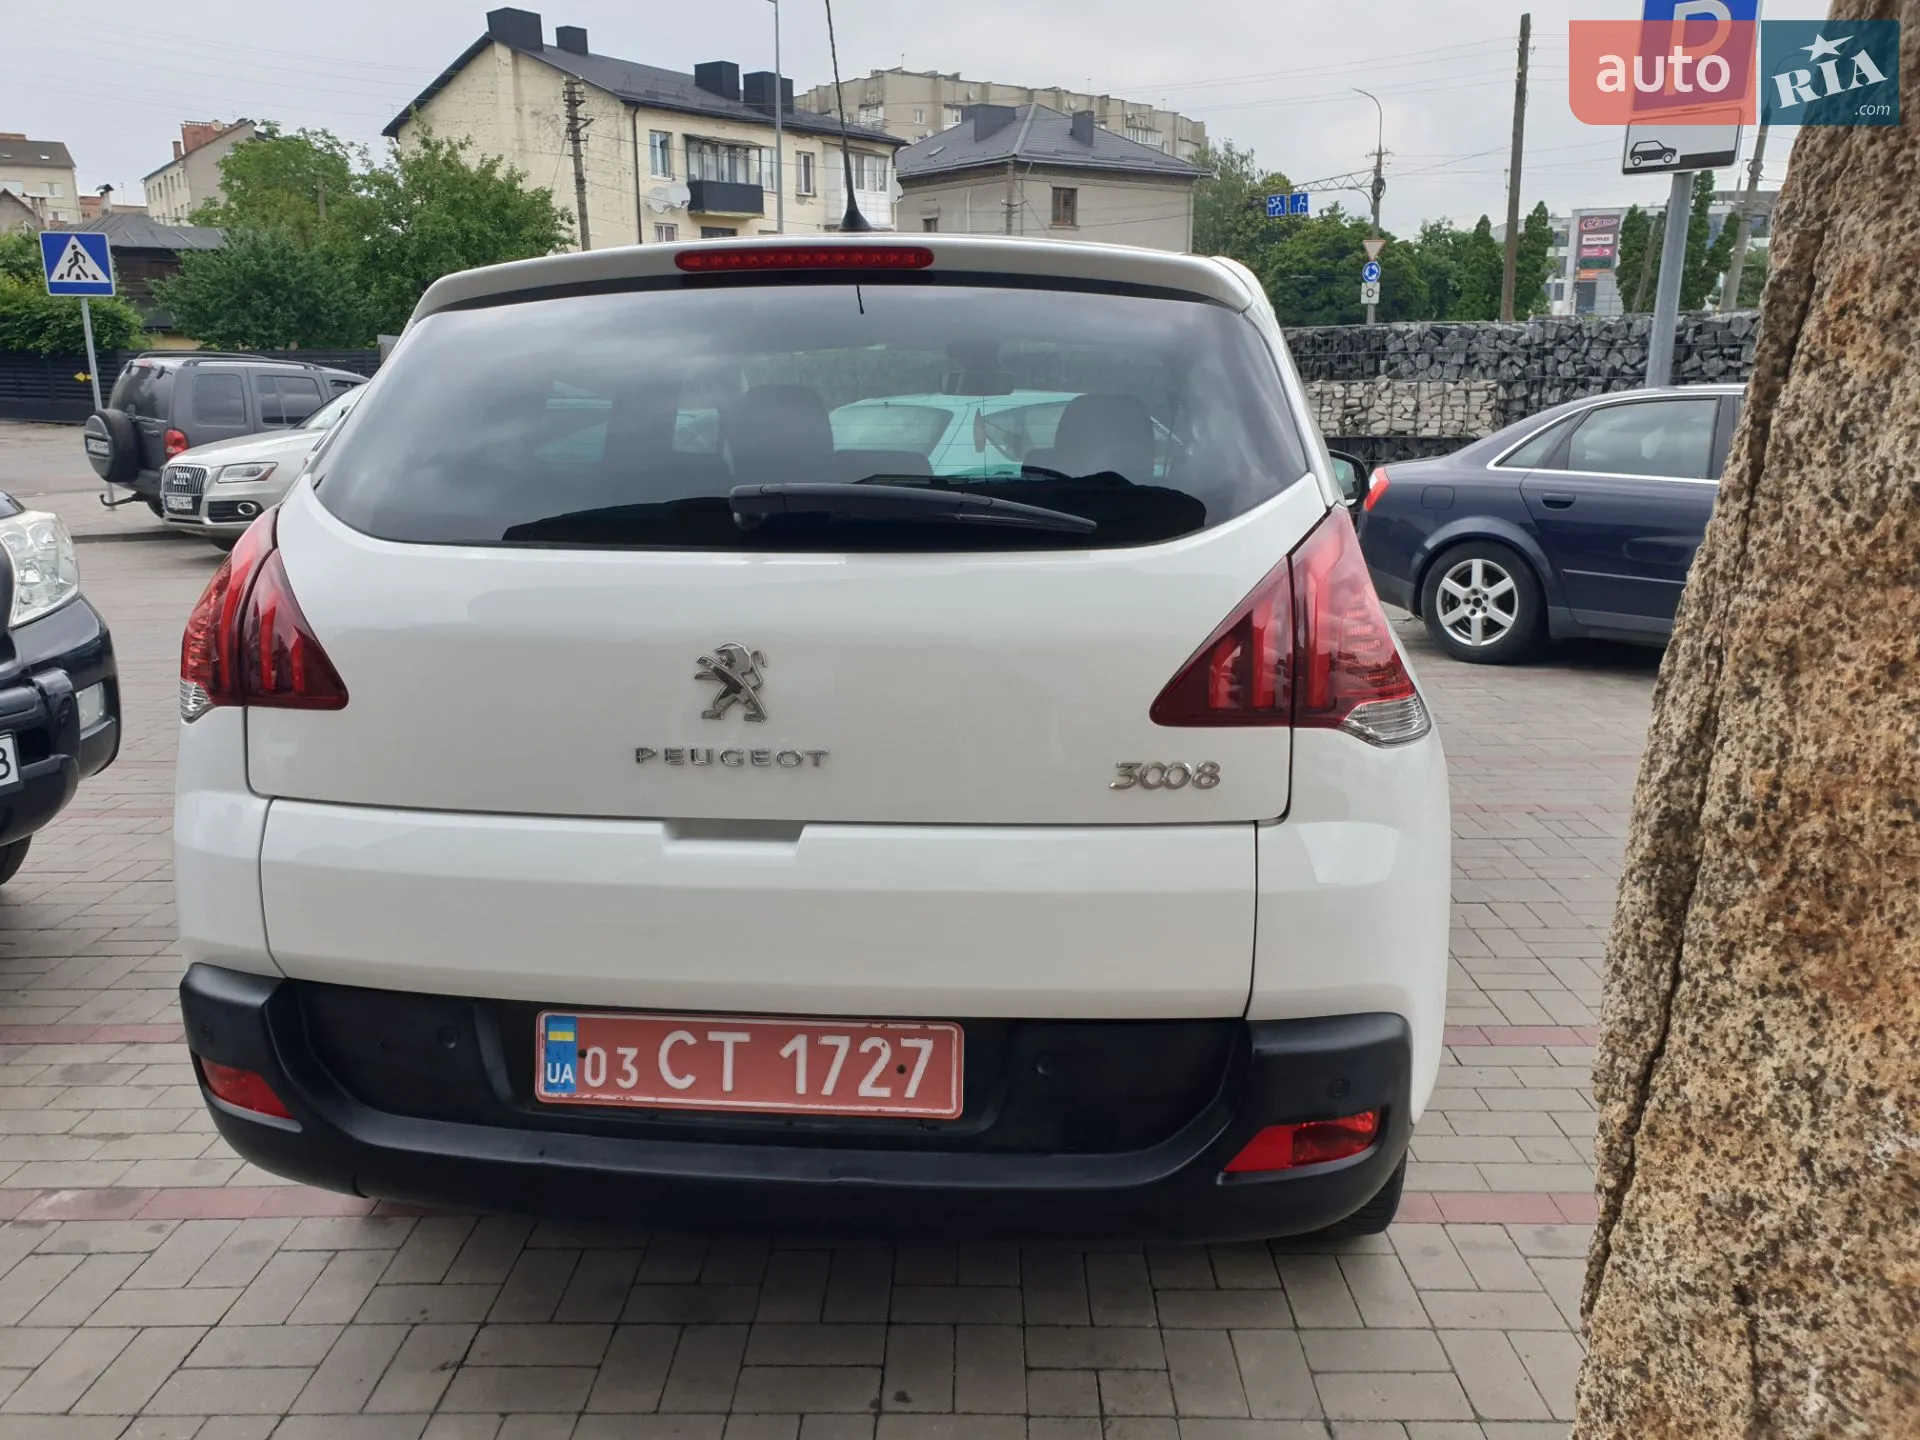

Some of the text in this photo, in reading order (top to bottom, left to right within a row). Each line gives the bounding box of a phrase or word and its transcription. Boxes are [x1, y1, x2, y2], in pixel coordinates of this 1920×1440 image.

[635, 747, 829, 768] PEUGEOT
[1109, 761, 1221, 790] 3008
[547, 1030, 934, 1098] UA 03 CT 1727
